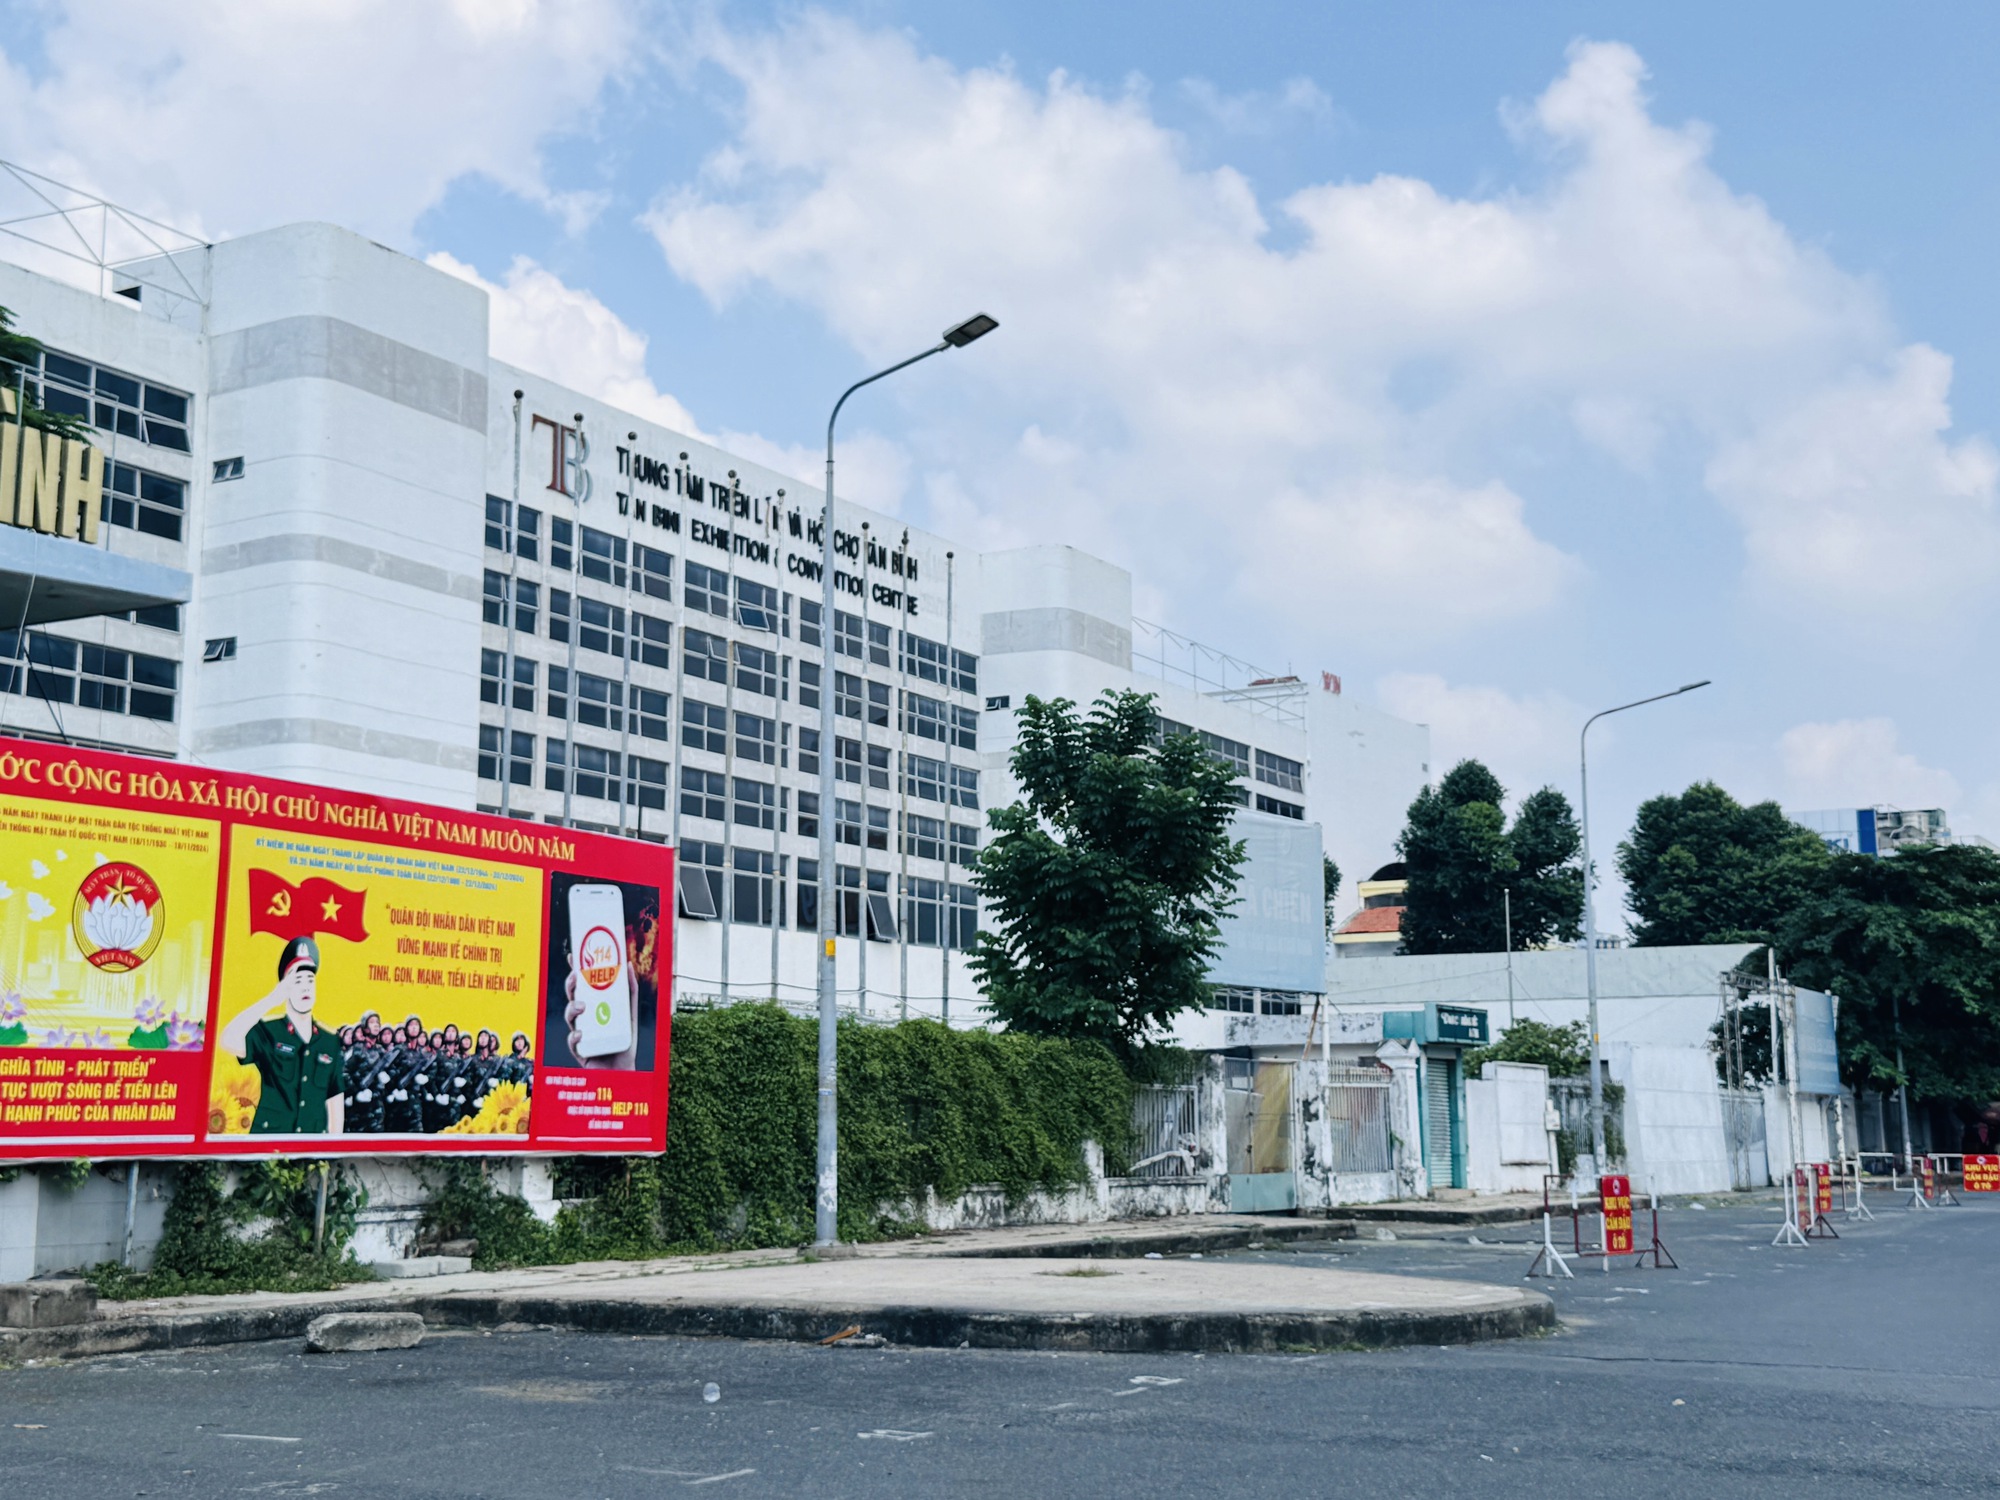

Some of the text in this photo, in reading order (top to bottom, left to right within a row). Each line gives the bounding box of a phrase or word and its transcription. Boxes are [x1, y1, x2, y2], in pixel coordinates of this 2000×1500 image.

[46, 759, 122, 794] CỘNG
[128, 771, 184, 802] HÒA
[188, 779, 221, 806] XÃ
[225, 785, 269, 818] HỘI
[273, 794, 319, 821] CHỦ
[324, 802, 389, 832] NGHĨA
[392, 812, 433, 842] VIỆT
[437, 820, 477, 846] NAM
[481, 828, 534, 854] MUÔN
[538, 836, 576, 862] NĂM
[416, 911, 430, 931] ĐỘI
[433, 911, 457, 930] NHÂN
[459, 913, 476, 932] DÂN
[478, 916, 495, 938] VIỆT
[497, 920, 516, 937] NAM
[423, 940, 448, 961] MẠNH
[463, 942, 488, 962] CHÍNH
[490, 947, 502, 967] TRỊ
[594, 945, 612, 963] 114
[417, 968, 445, 989] MẠNH,
[448, 966, 466, 987] TIẾN
[468, 970, 483, 989] LÊN
[486, 972, 505, 995] HIỆN
[590, 967, 615, 984] HELP
[35, 1056, 65, 1076] TÌNH
[76, 1057, 111, 1077] PHÁT
[1, 1077, 178, 1102] TỤC VƯỢT SÓNG ĐỂ TIẾN LÊN
[597, 1087, 612, 1101] 114
[5, 1105, 43, 1125] HẠNH
[46, 1101, 81, 1122] PHÚC
[84, 1100, 109, 1121] CỦA
[113, 1101, 148, 1121] NHÂN
[150, 1101, 176, 1121] DÂN
[612, 1101, 633, 1116] HELP
[634, 1102, 649, 1116] 114
